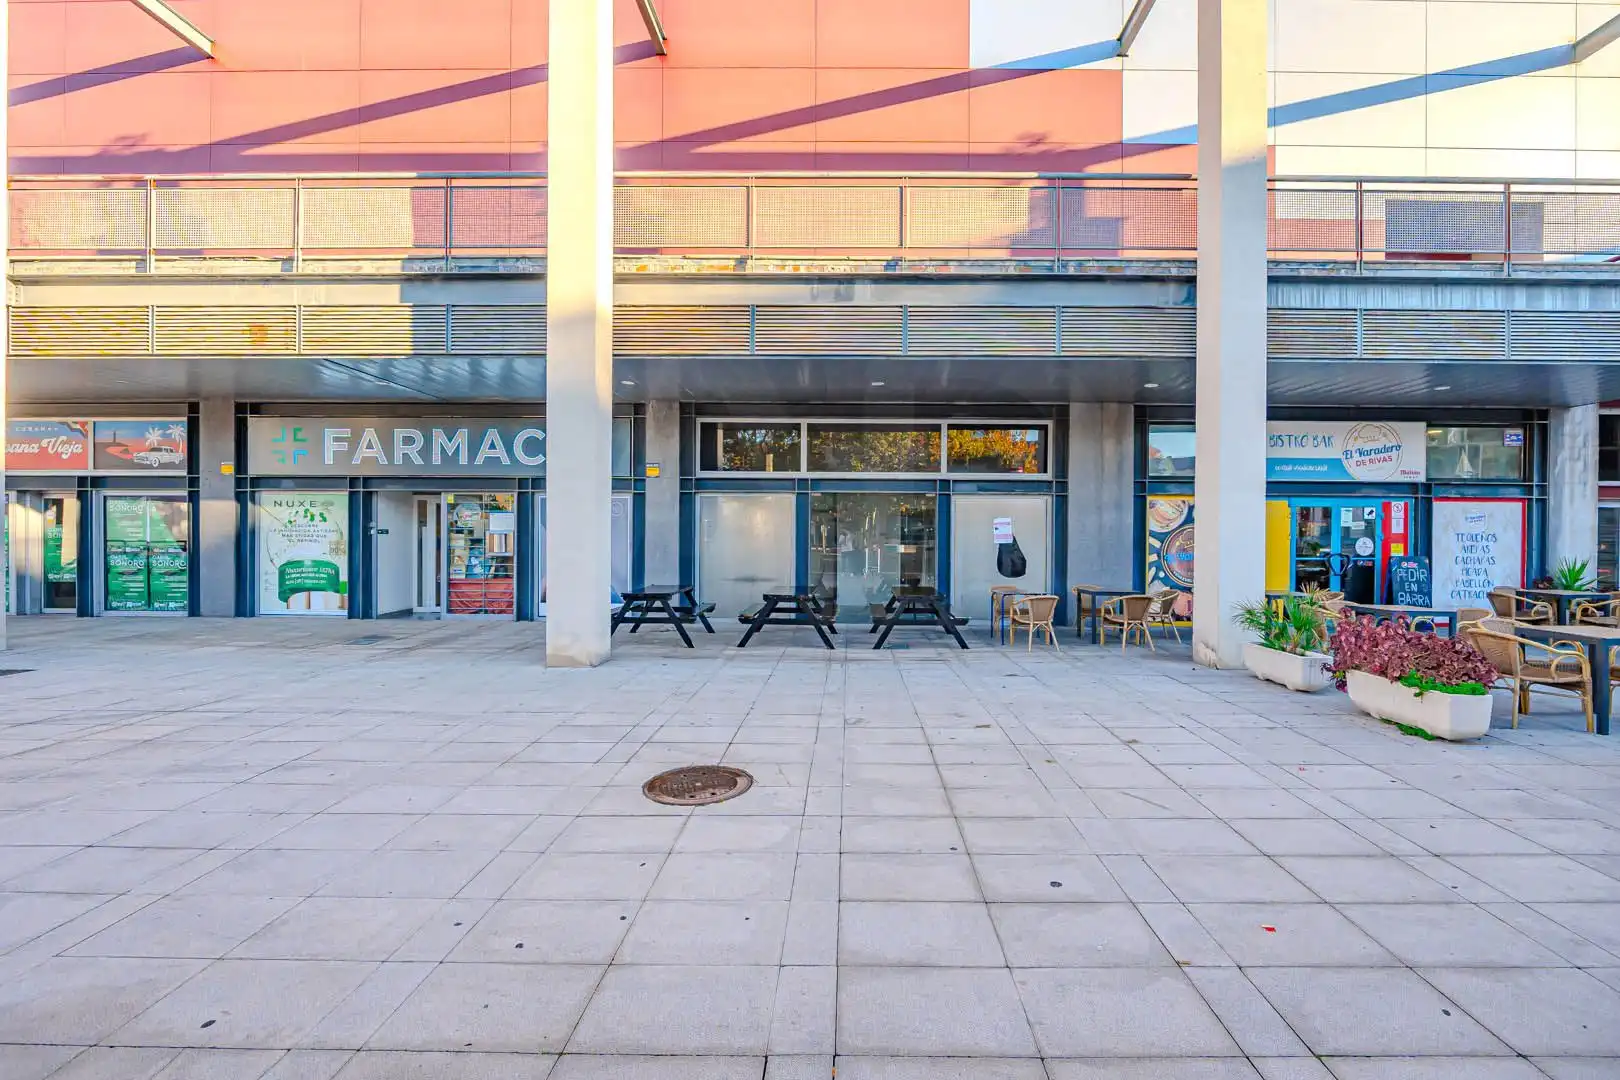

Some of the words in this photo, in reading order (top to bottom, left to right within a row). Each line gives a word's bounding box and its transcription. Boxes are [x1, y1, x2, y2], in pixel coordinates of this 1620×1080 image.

[41, 436, 83, 459] Vieja
[323, 428, 546, 465] FARMAC
[1312, 433, 1334, 448] BAR
[1343, 450, 1354, 460] El
[1355, 444, 1402, 457] Varadero
[1368, 456, 1393, 465] RIVAS
[110, 560, 145, 569] SONORO
[152, 560, 187, 569] SONORO
[1397, 566, 1428, 582] PEDIR
[1404, 582, 1418, 592] EN
[1398, 592, 1431, 606] BARRA
